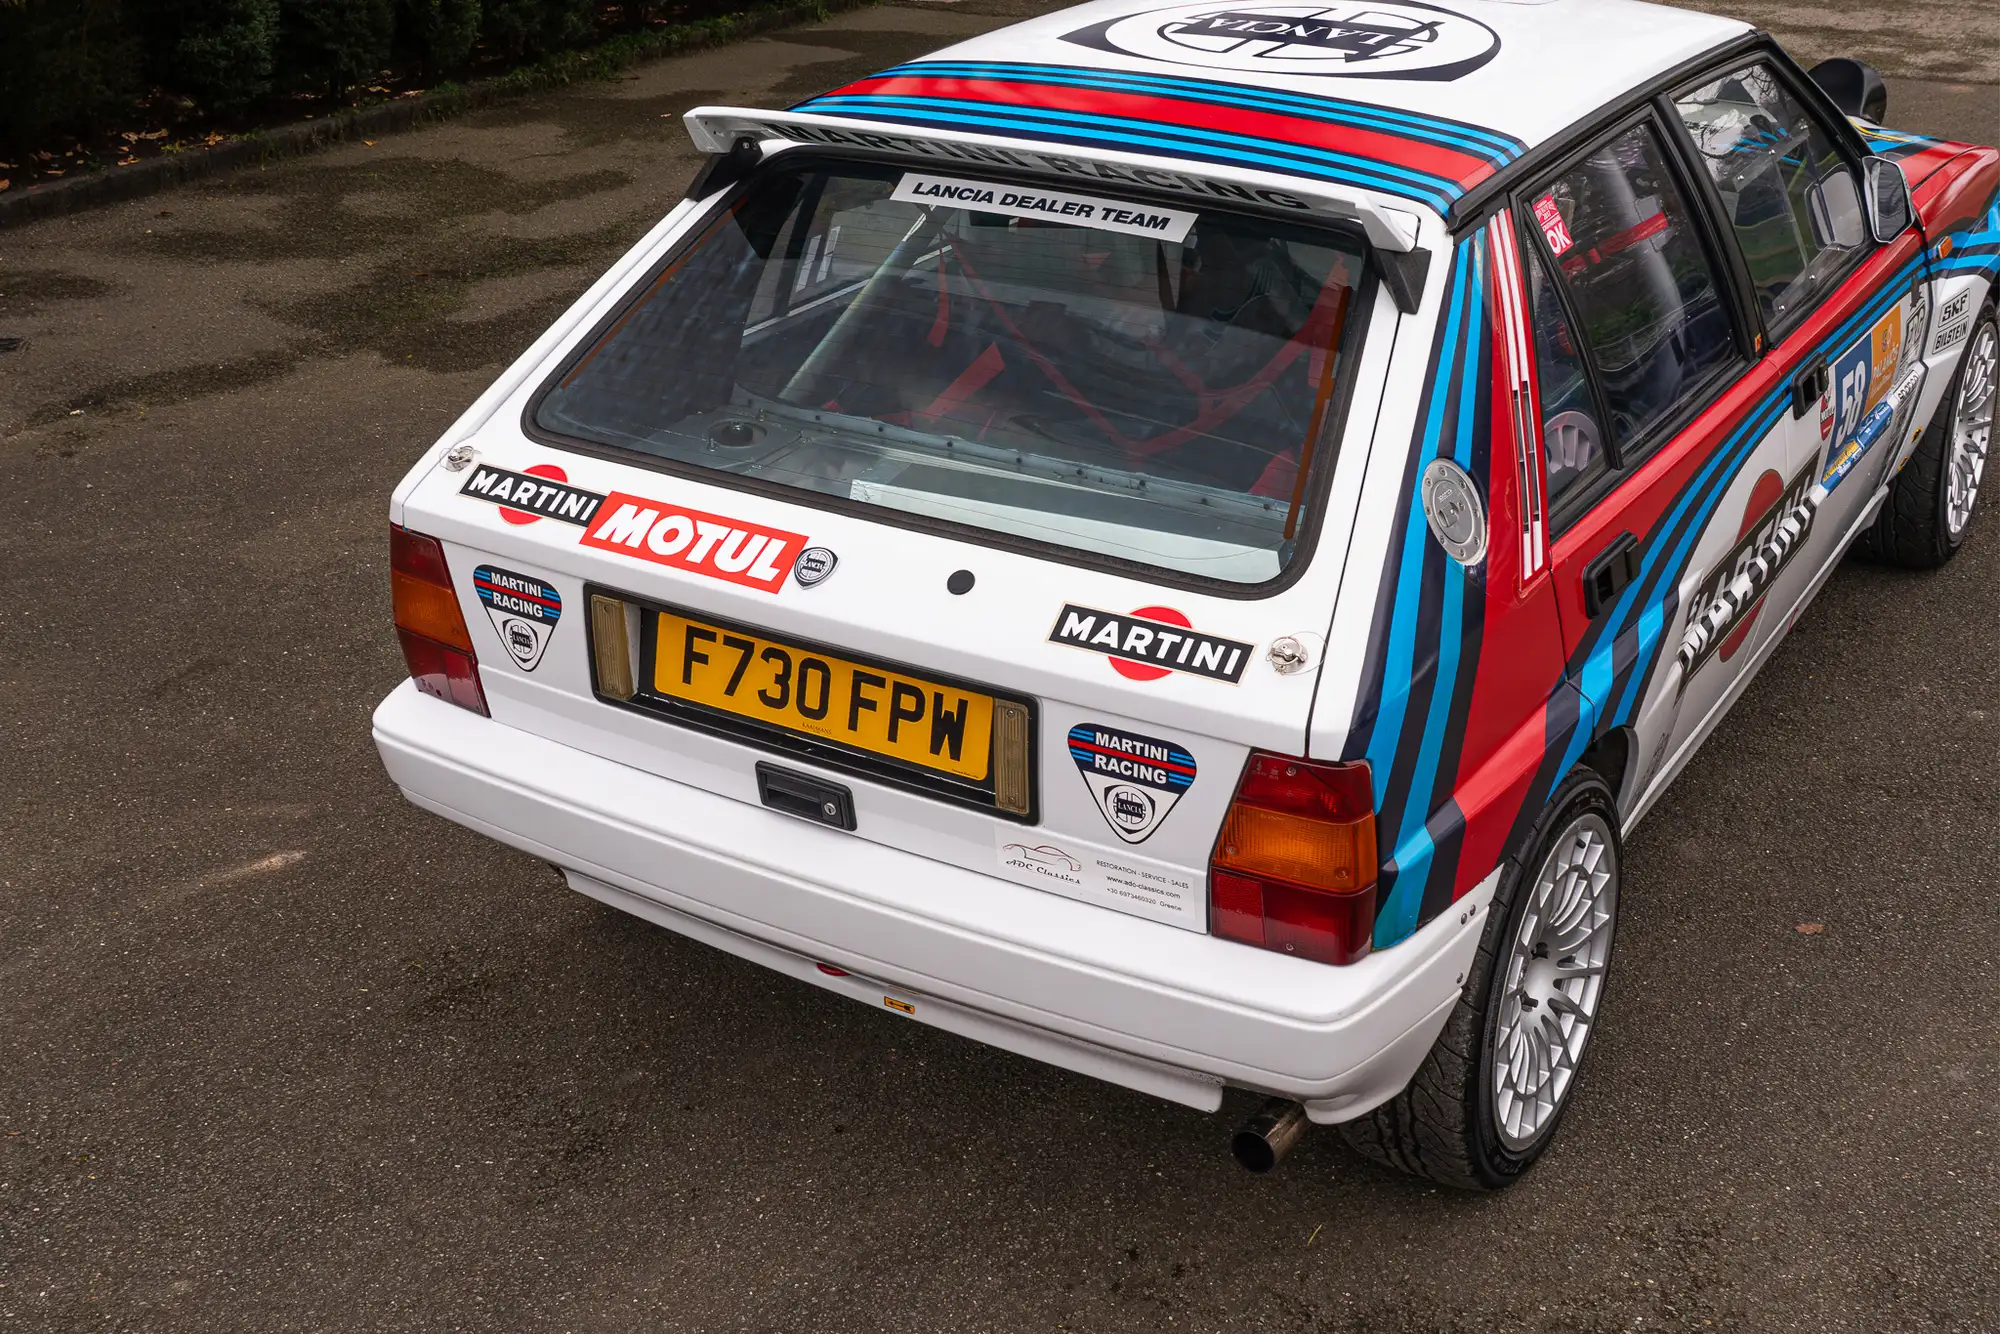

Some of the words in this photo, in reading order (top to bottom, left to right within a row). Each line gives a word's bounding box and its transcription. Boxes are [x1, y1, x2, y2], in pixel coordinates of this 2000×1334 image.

[1208, 18, 1397, 46] LANCIA
[760, 122, 1032, 168] MARTINI
[1036, 154, 1312, 210] RACING
[912, 182, 994, 204] LANCIA
[999, 193, 1095, 218] DEALER
[1100, 207, 1171, 231] TEAM
[1546, 221, 1571, 254] OK
[1941, 294, 1968, 322] SKF
[1935, 321, 1967, 350] BILSTEIN
[1834, 360, 1866, 449] 58
[467, 469, 599, 521] MARTINI
[593, 503, 788, 582] MOTUL
[491, 572, 542, 598] MARTINI
[493, 592, 544, 618] RACING
[1060, 611, 1242, 676] MARTINI
[683, 624, 831, 721] F730
[848, 670, 969, 762] FPW
[1095, 732, 1168, 762] MARTINI
[1095, 754, 1167, 784] RACING
[1117, 801, 1143, 814] LANCIA
[1006, 859, 1033, 871] ADC
[1037, 866, 1081, 885] Classics
[1096, 860, 1137, 875] RESTORATION
[1141, 872, 1167, 884] SERVICE
[1171, 879, 1189, 890] SALES
[1159, 901, 1182, 912] Greece
